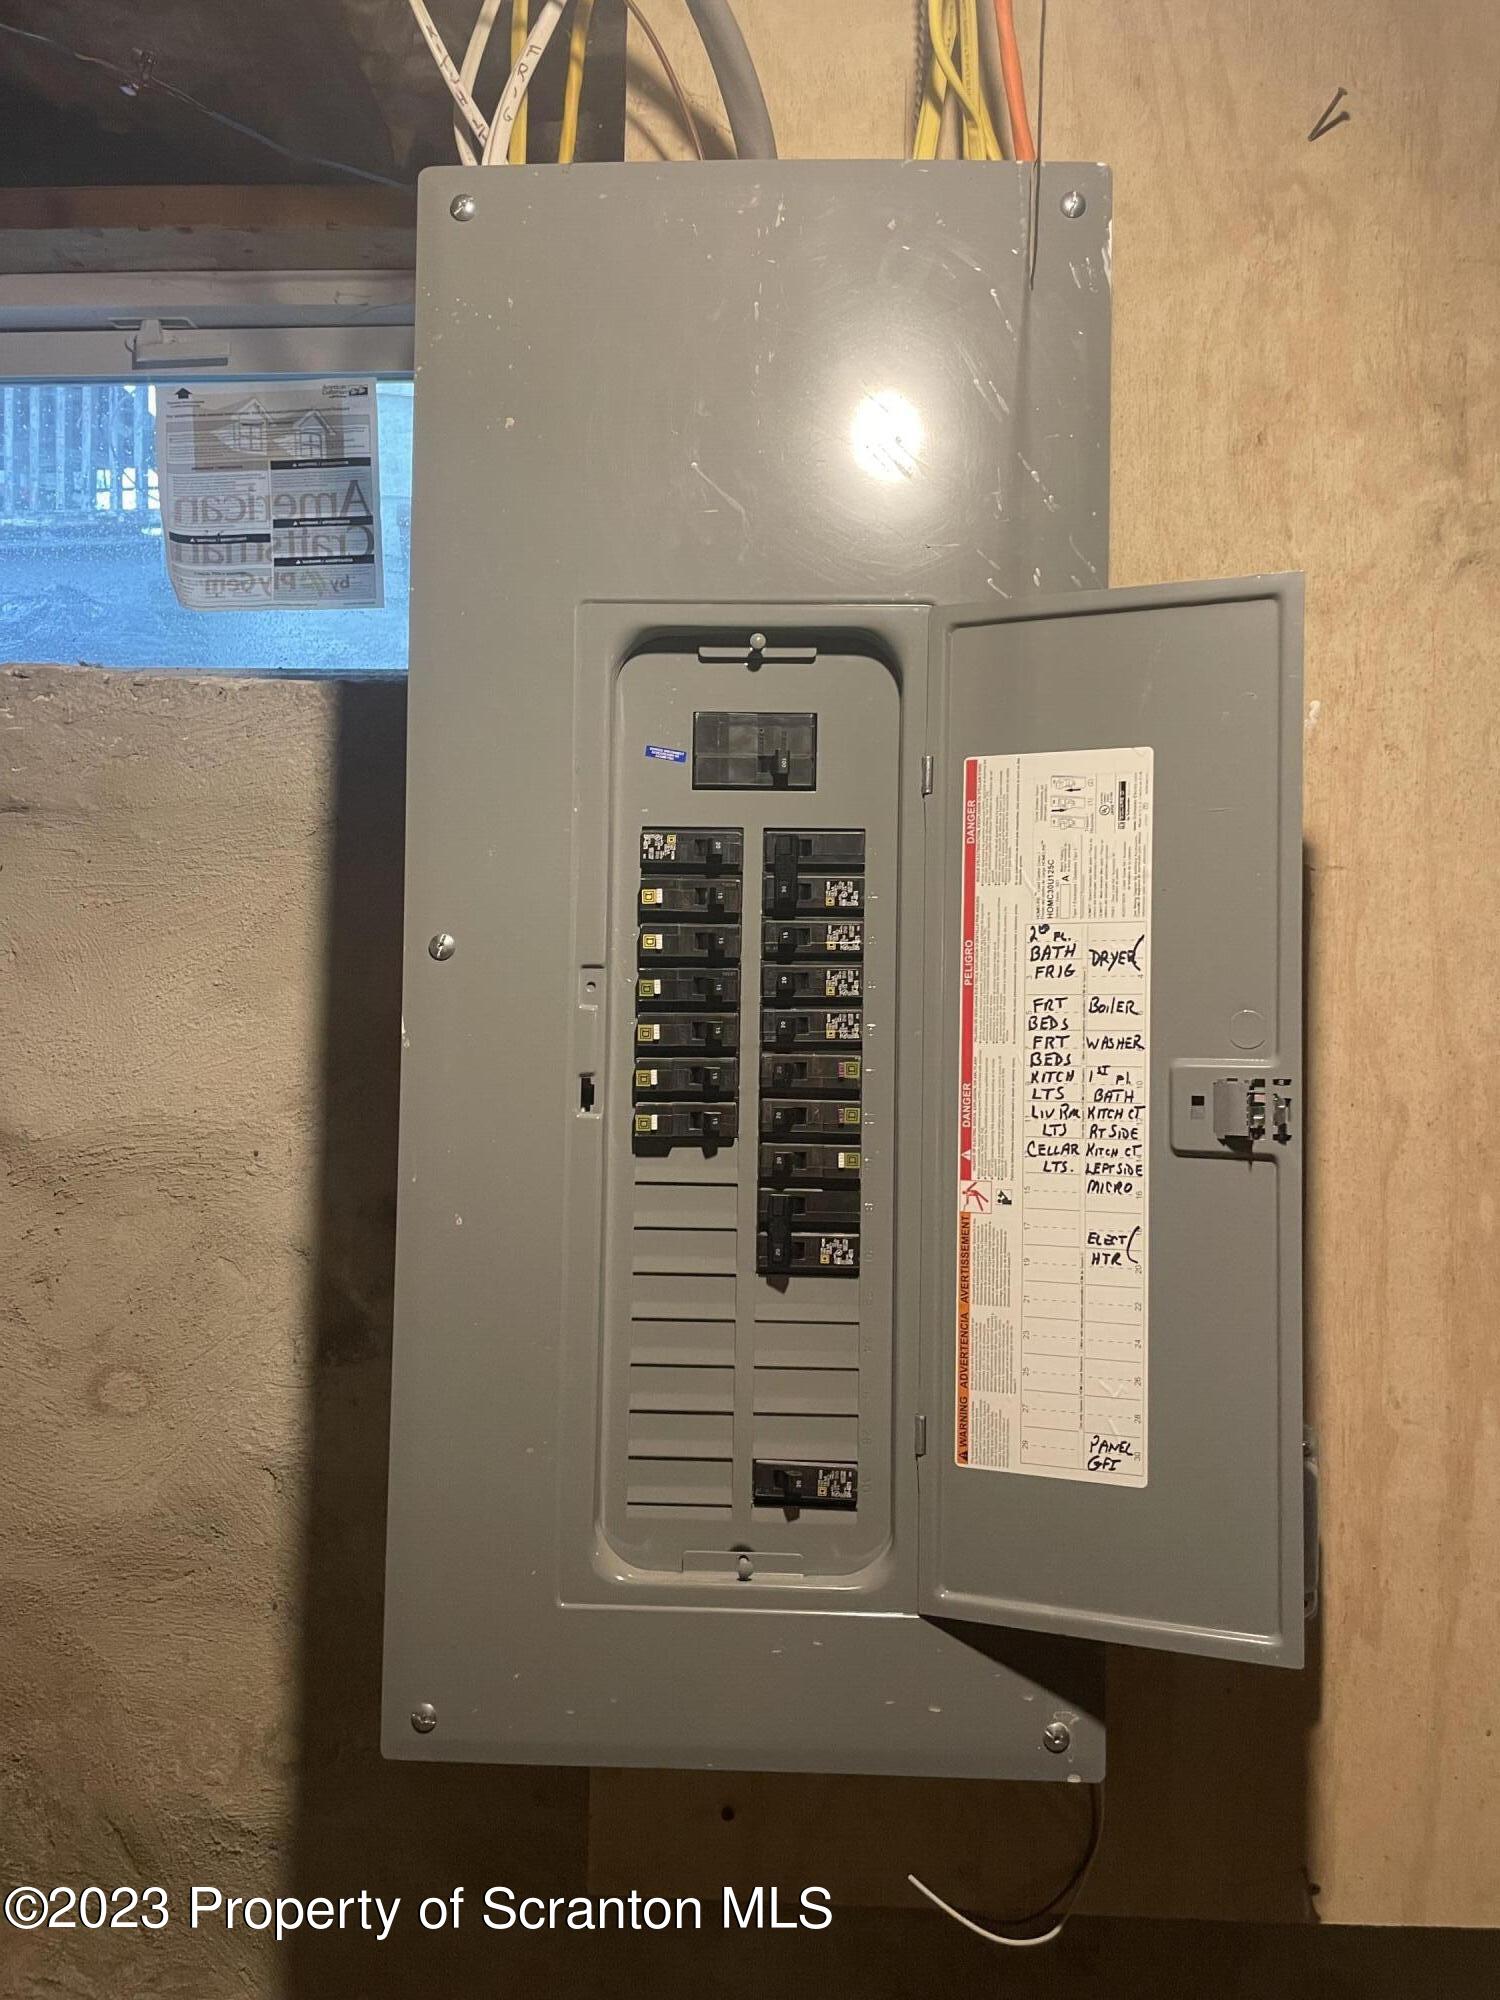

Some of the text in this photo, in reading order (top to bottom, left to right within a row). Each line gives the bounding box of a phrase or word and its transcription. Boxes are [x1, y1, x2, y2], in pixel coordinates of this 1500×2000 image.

[503, 44, 542, 123] FRIG
[966, 799, 976, 845] DANGER
[1030, 943, 1077, 962] BATH
[1089, 949, 1137, 972] DRYER
[964, 939, 974, 986] PELIGRO
[1035, 963, 1077, 979] FRIG
[1033, 997, 1069, 1013] FRT
[1028, 1015, 1069, 1031] BEDS
[1033, 1035, 1071, 1049] FRT
[1086, 1034, 1146, 1050] WASHER
[1030, 1052, 1071, 1068] BEDS
[1031, 1070, 1075, 1084] KITCH
[1032, 1087, 1065, 1100] LTS
[1094, 1088, 1135, 1103] BATH
[962, 1083, 972, 1128] DANGER
[1088, 1105, 1124, 1119] KITCH
[1090, 1124, 1107, 1139] RT
[1027, 1140, 1080, 1157] CELLAR
[1086, 1143, 1119, 1158] KITCH
[1116, 1163, 1143, 1177] SIDE
[1087, 1180, 1134, 1195] MICRO
[961, 1215, 970, 1303] AVERTISSEMENT
[1092, 1252, 1122, 1266] HTR
[961, 1312, 970, 1389] ADVERTENCIA
[959, 1395, 968, 1448] WARNING
[1090, 1434, 1134, 1456] PANEL
